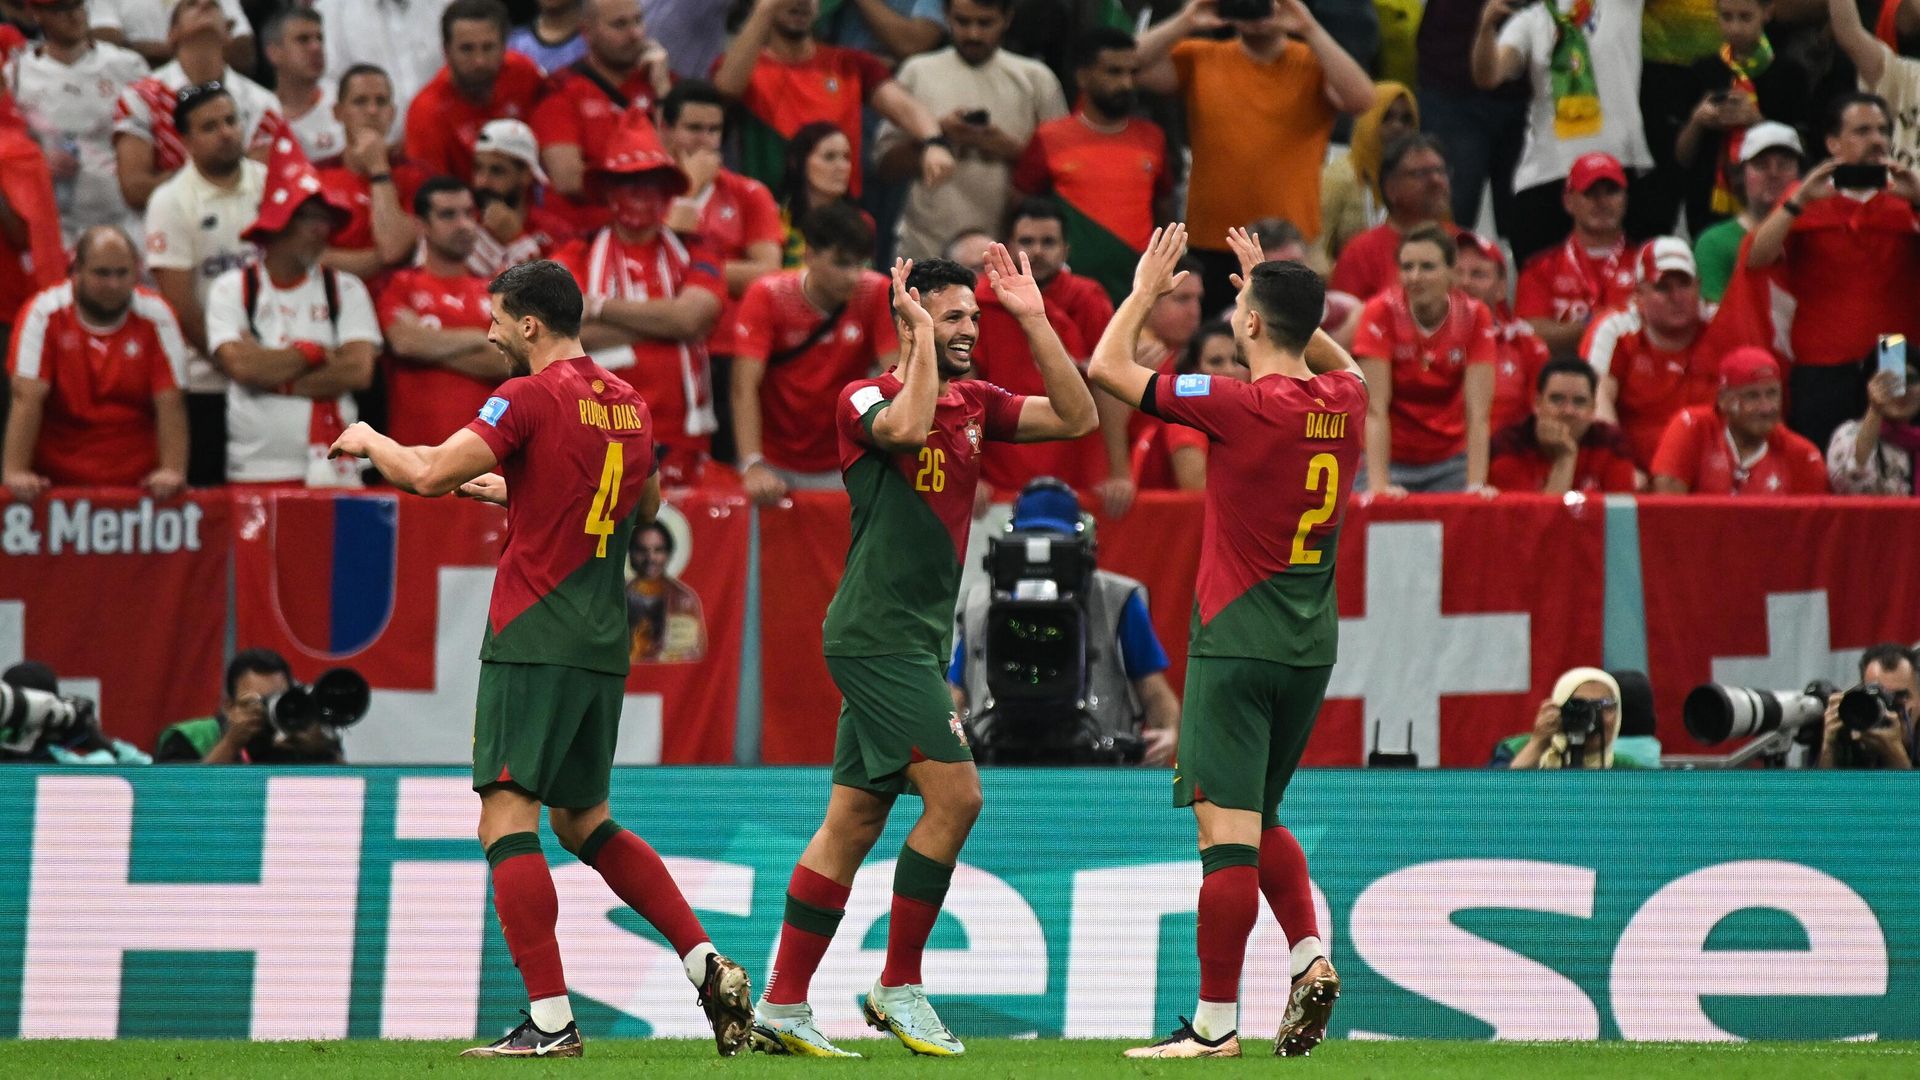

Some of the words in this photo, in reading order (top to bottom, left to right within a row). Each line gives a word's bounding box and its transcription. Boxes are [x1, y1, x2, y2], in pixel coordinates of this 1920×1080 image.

[612, 404, 641, 430] DIAS
[1306, 412, 1348, 439] DALOT
[584, 441, 623, 558] 4
[915, 446, 946, 493] 26
[3, 504, 41, 556] &
[49, 496, 203, 555] Merlot
[1289, 452, 1339, 564] 2
[18, 775, 1889, 1042] Hisense
